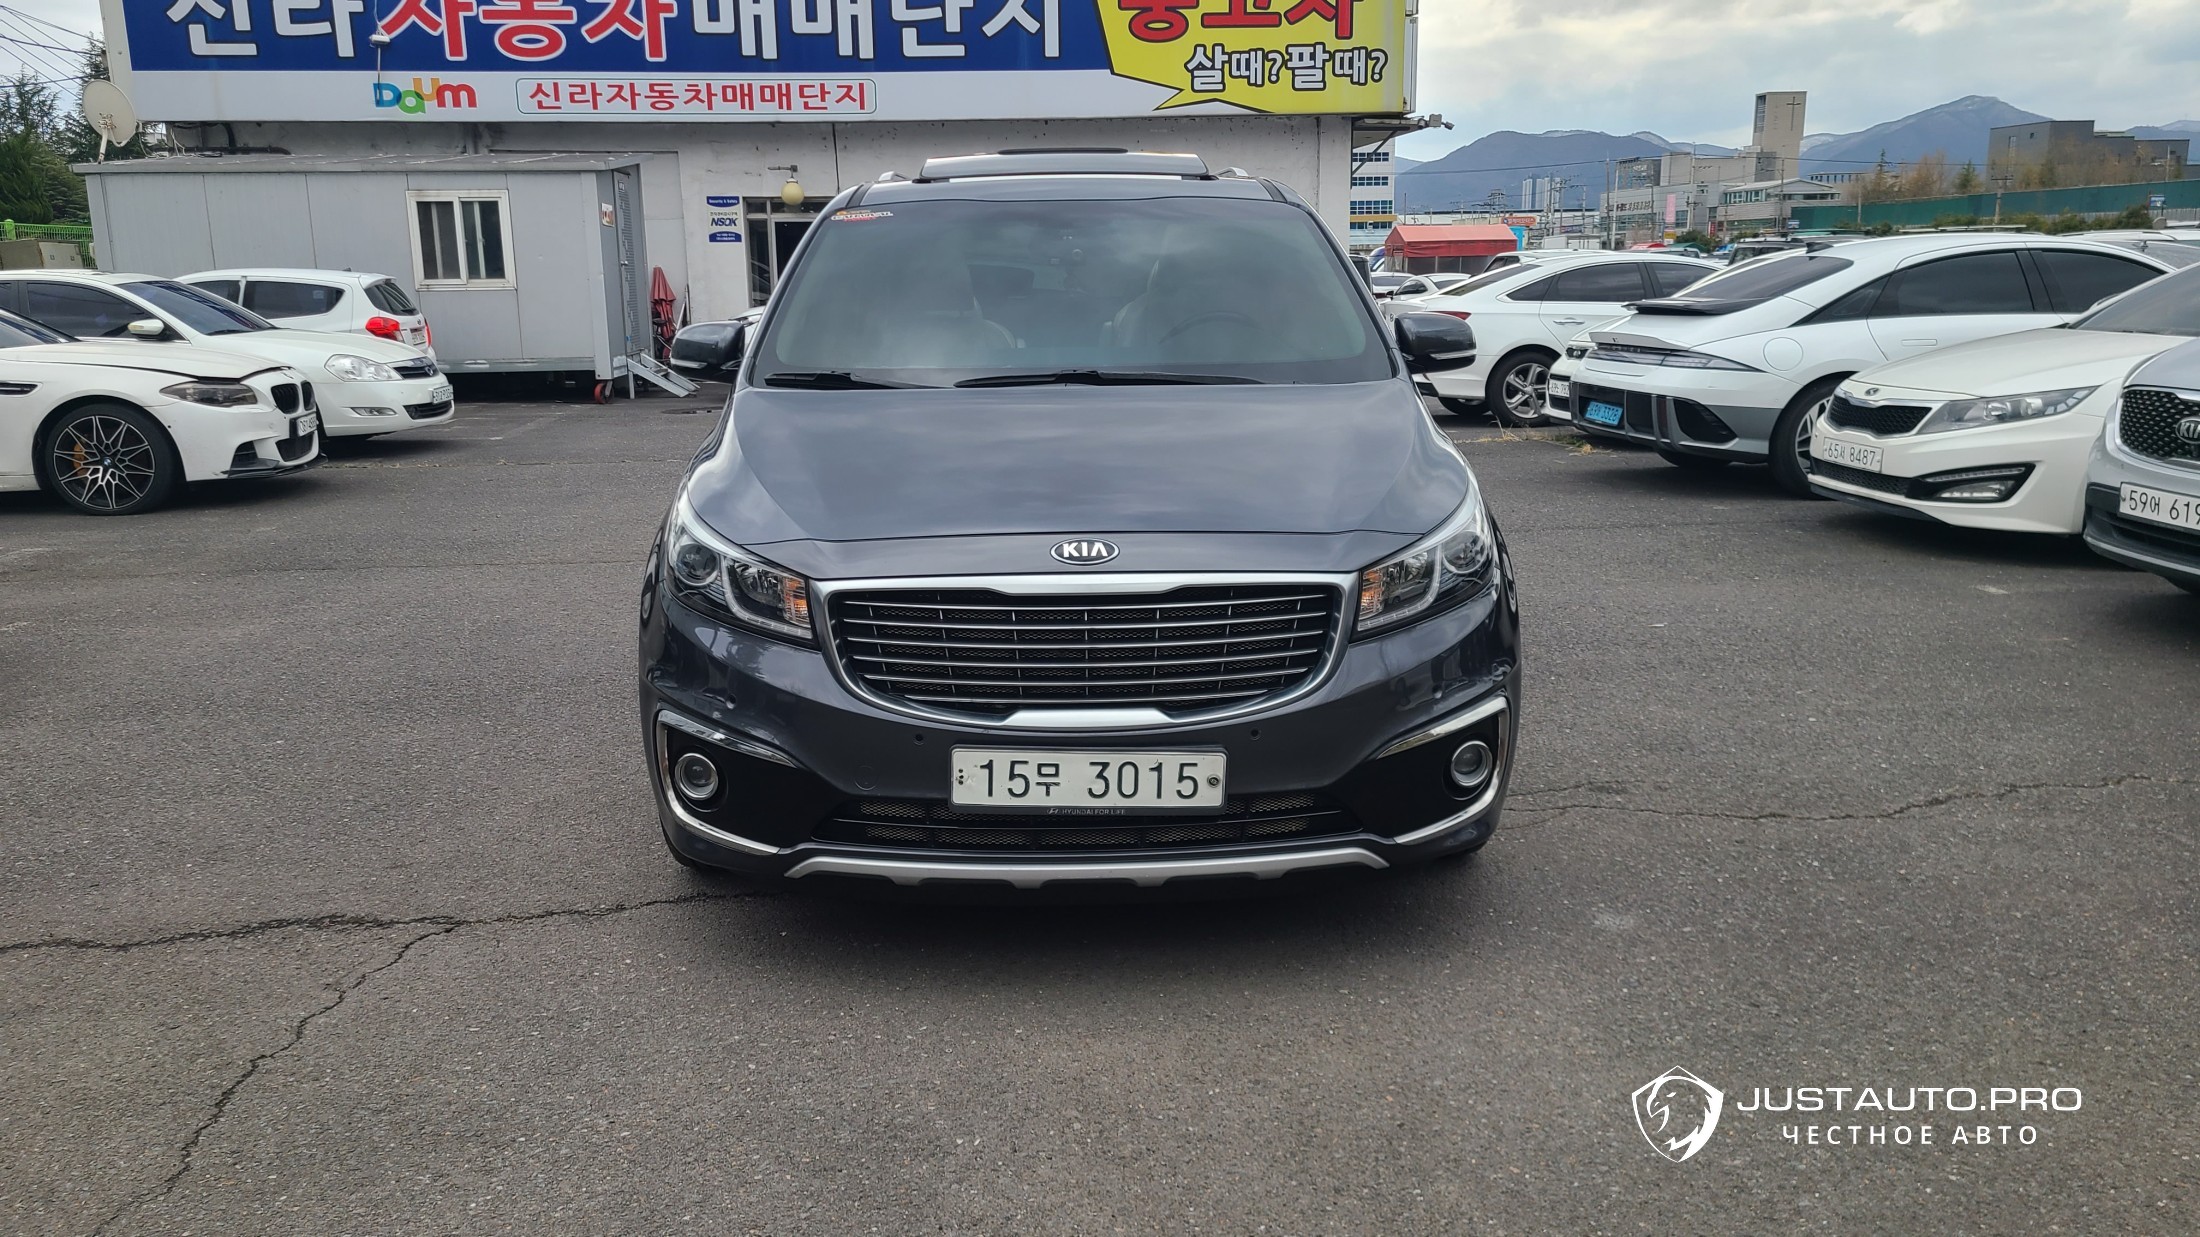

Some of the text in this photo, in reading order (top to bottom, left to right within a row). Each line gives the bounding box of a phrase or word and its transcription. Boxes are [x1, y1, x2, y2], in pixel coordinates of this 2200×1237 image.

[529, 81, 867, 111] 신라자동차매매단지
[1849, 446, 1876, 467] 8487
[2129, 490, 2160, 516] 59어
[1062, 541, 1109, 558] KIA
[980, 759, 1199, 799] 15무 3015
